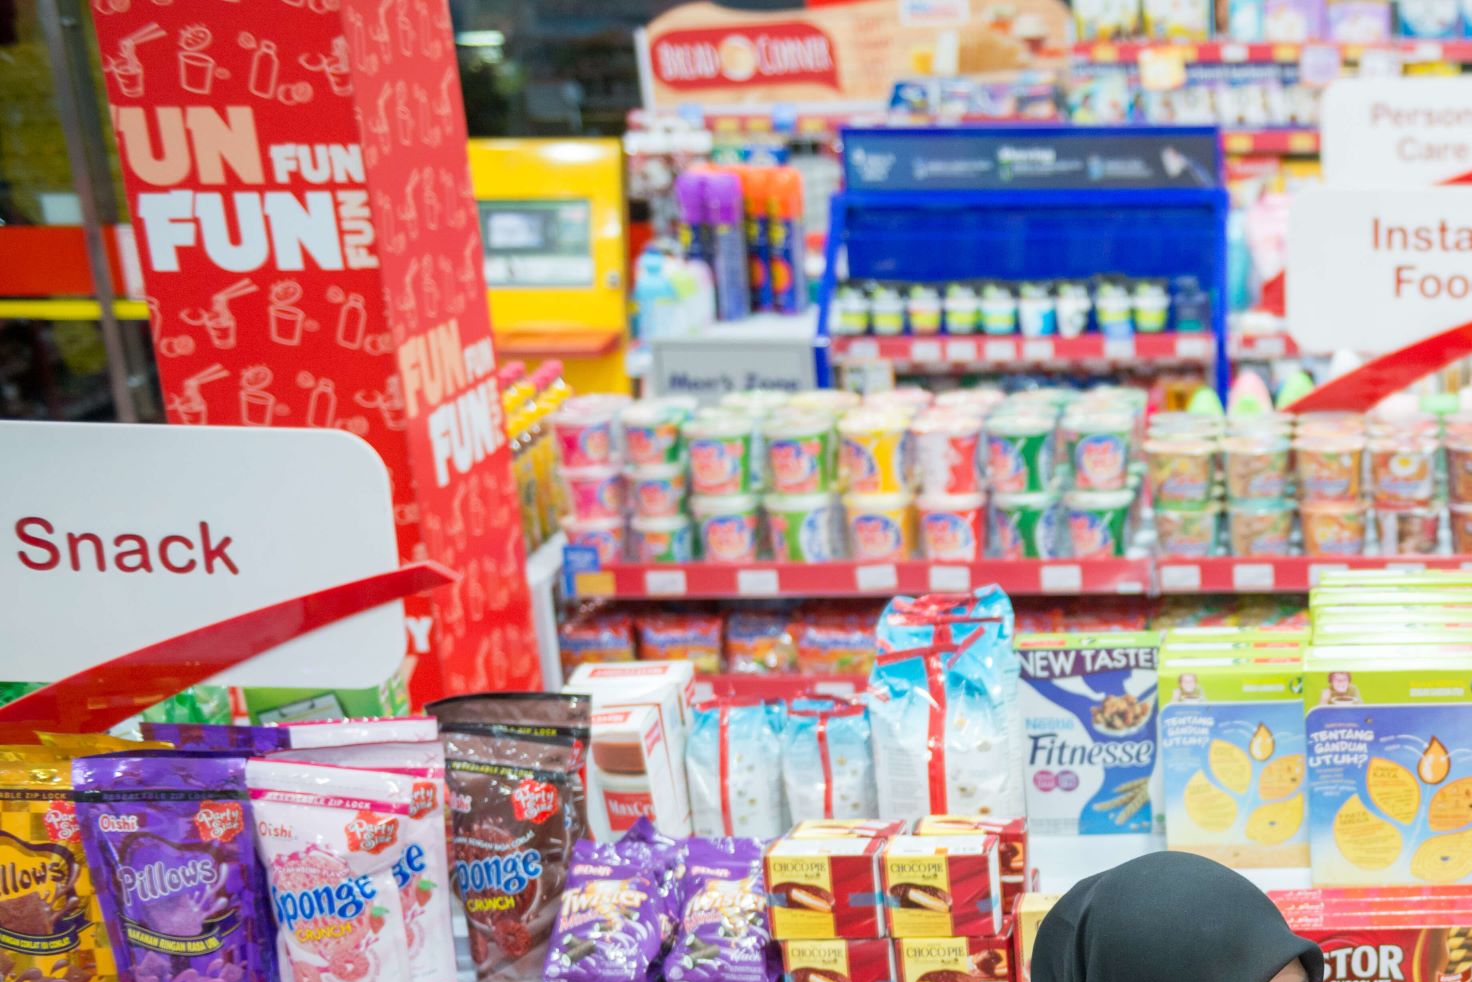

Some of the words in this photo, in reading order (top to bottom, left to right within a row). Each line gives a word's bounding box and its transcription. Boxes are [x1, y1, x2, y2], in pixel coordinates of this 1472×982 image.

[111, 104, 264, 186] UN
[1396, 137, 1470, 164] Care
[270, 142, 366, 184] FUN
[138, 189, 344, 273] FUN
[341, 189, 380, 270] FUN
[399, 317, 466, 418] FUN
[428, 382, 498, 488] FUN
[13, 515, 240, 576] Snack
[1020, 652, 1076, 678] NEW
[1082, 647, 1158, 670] TASTE!
[1029, 731, 1153, 768] Fitnesse
[1310, 728, 1375, 742] TENTANG
[1314, 742, 1368, 754] GANDUM
[1308, 755, 1368, 767] UTUH?
[99, 814, 140, 832] Oishi
[199, 808, 240, 825] Party
[258, 821, 293, 839] Oishi
[350, 819, 394, 839] Party
[118, 859, 217, 906] Pillows
[467, 896, 515, 914] CRUNCH
[295, 923, 352, 943] CRUNCH
